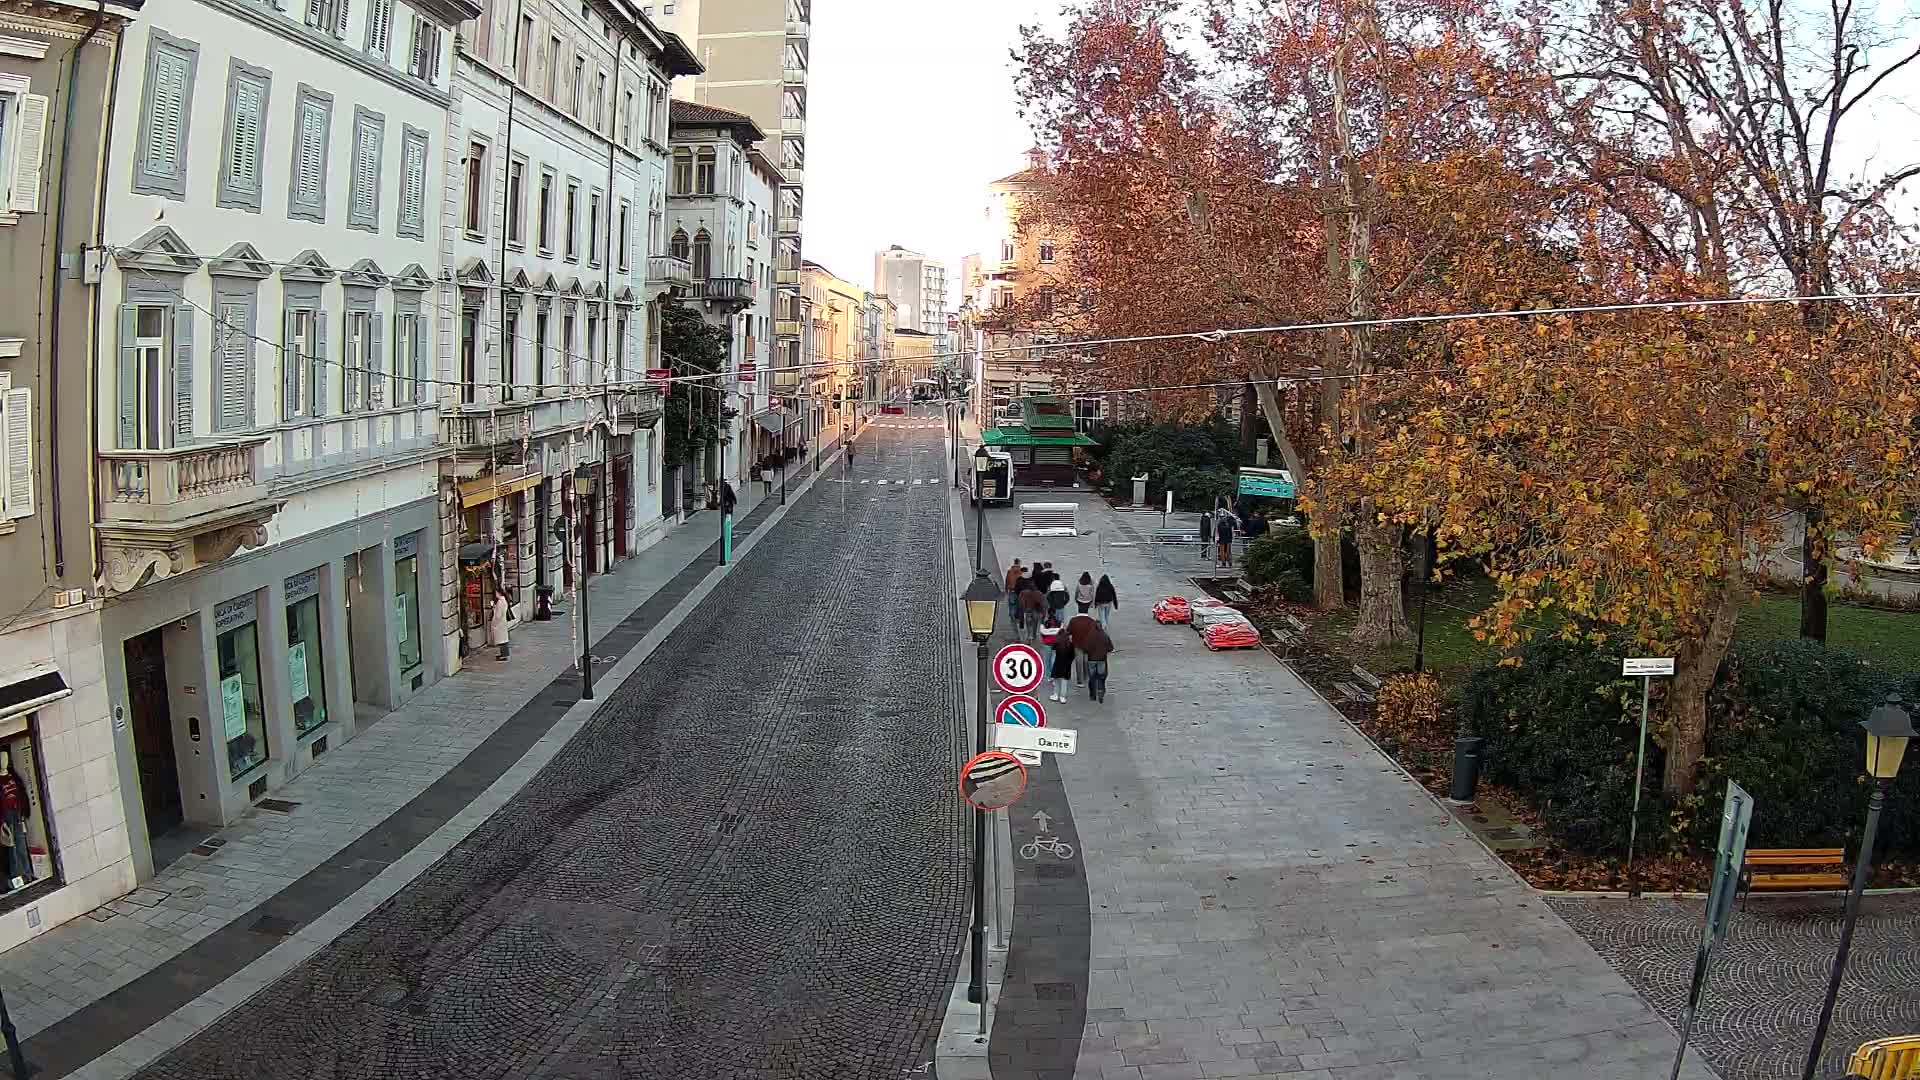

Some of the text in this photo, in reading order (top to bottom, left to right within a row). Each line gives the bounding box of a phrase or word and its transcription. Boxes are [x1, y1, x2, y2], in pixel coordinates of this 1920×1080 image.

[216, 611, 245, 628] OPERATIVO
[1005, 658, 1032, 680] 30
[1038, 738, 1069, 748] Dante
